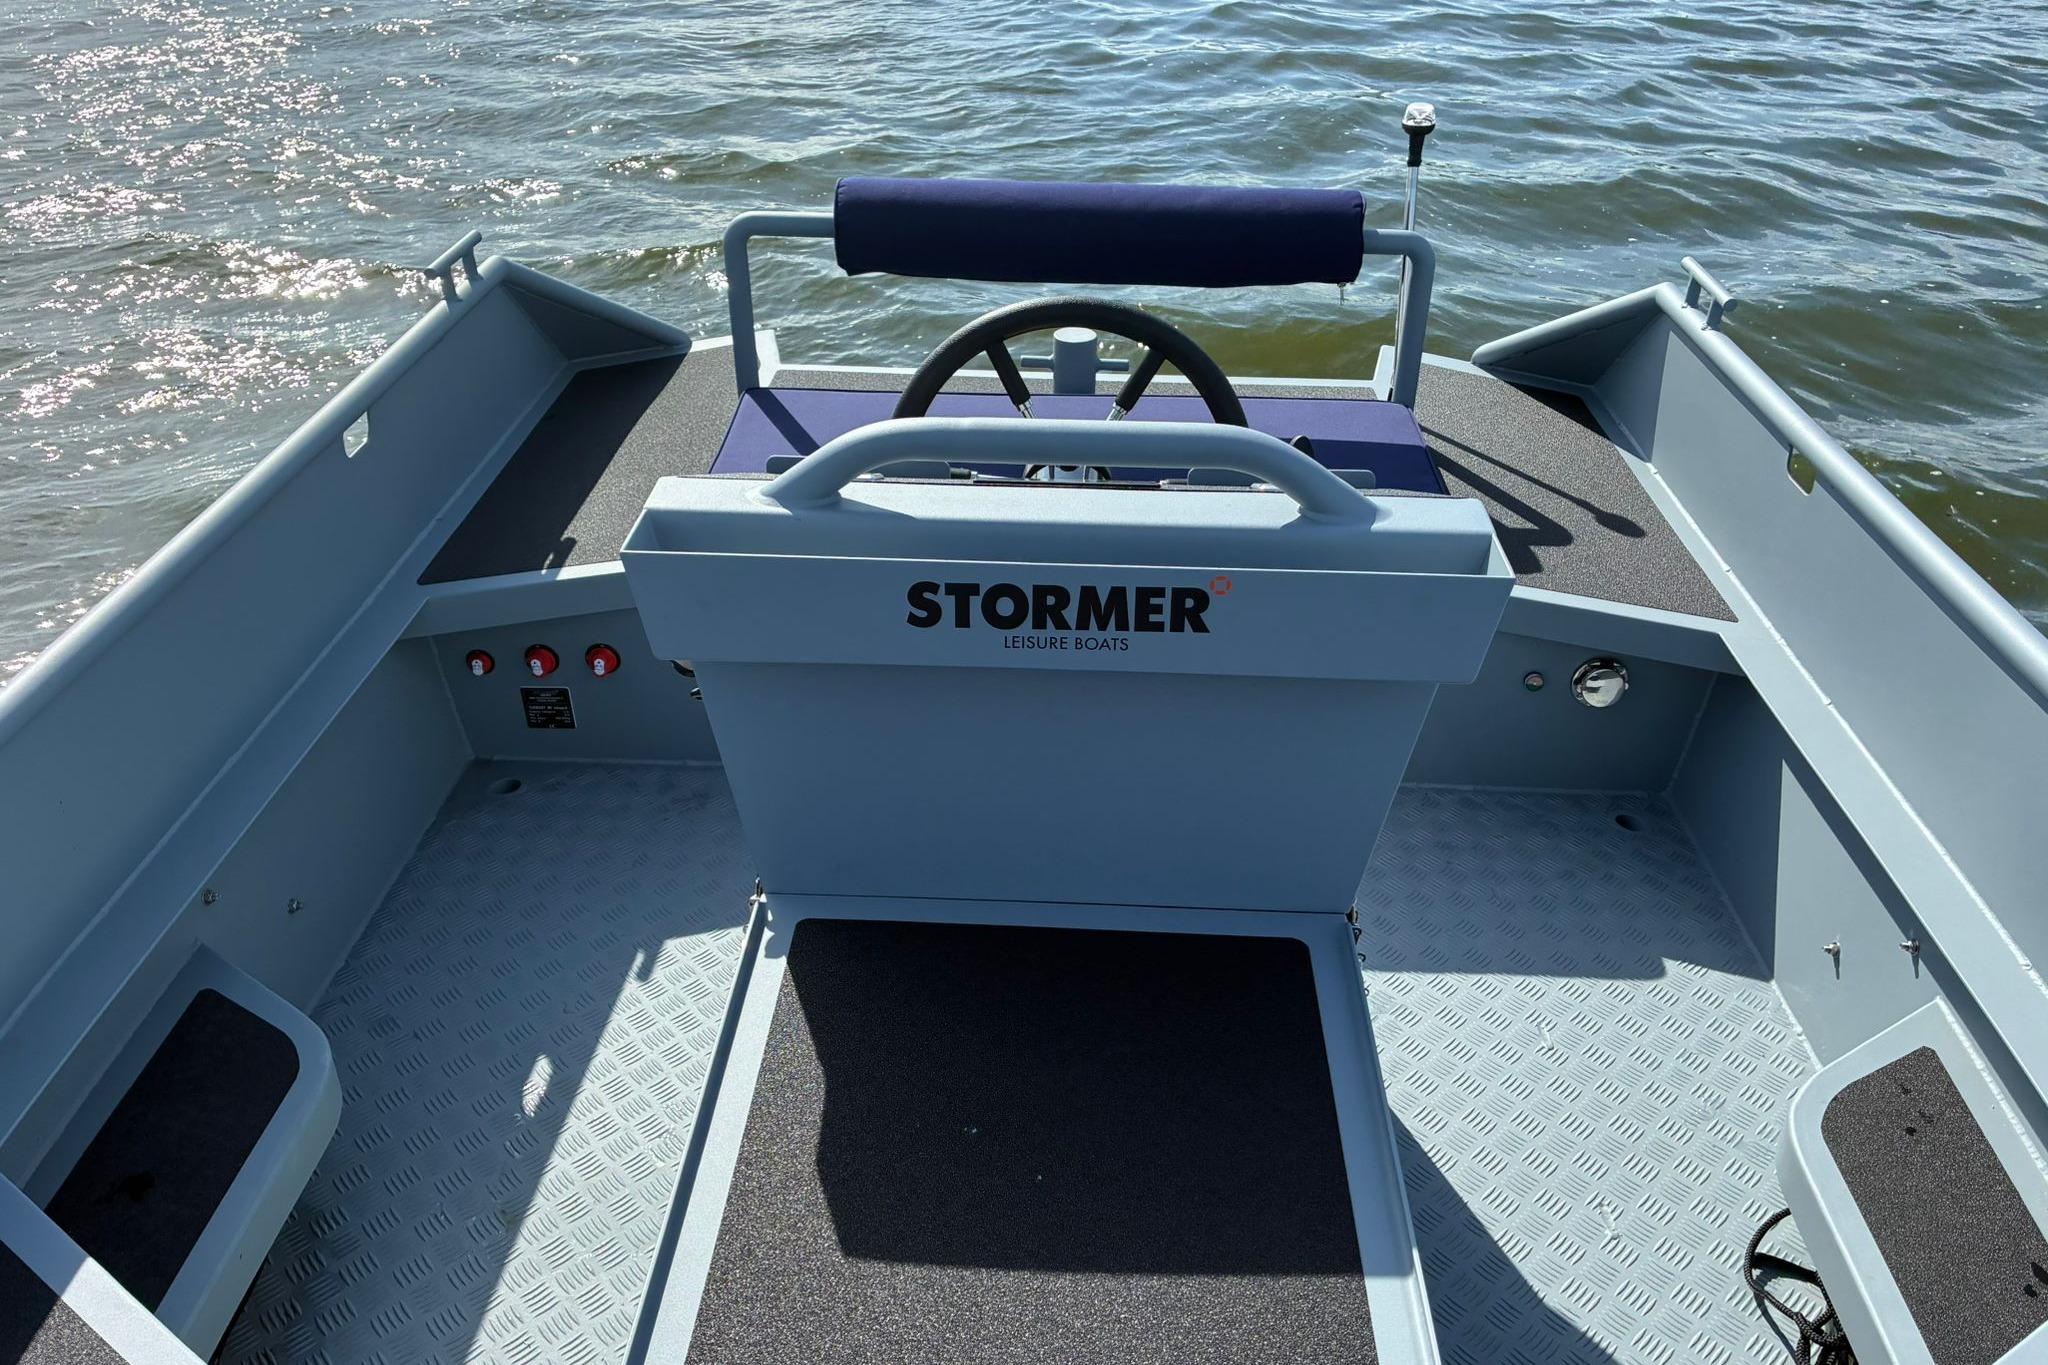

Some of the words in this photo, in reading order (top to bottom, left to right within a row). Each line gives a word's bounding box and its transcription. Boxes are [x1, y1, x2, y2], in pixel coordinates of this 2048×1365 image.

[906, 580, 1211, 634] STORMER
[1004, 635, 1068, 651] LEISURE
[1074, 637, 1130, 652] BOATS
